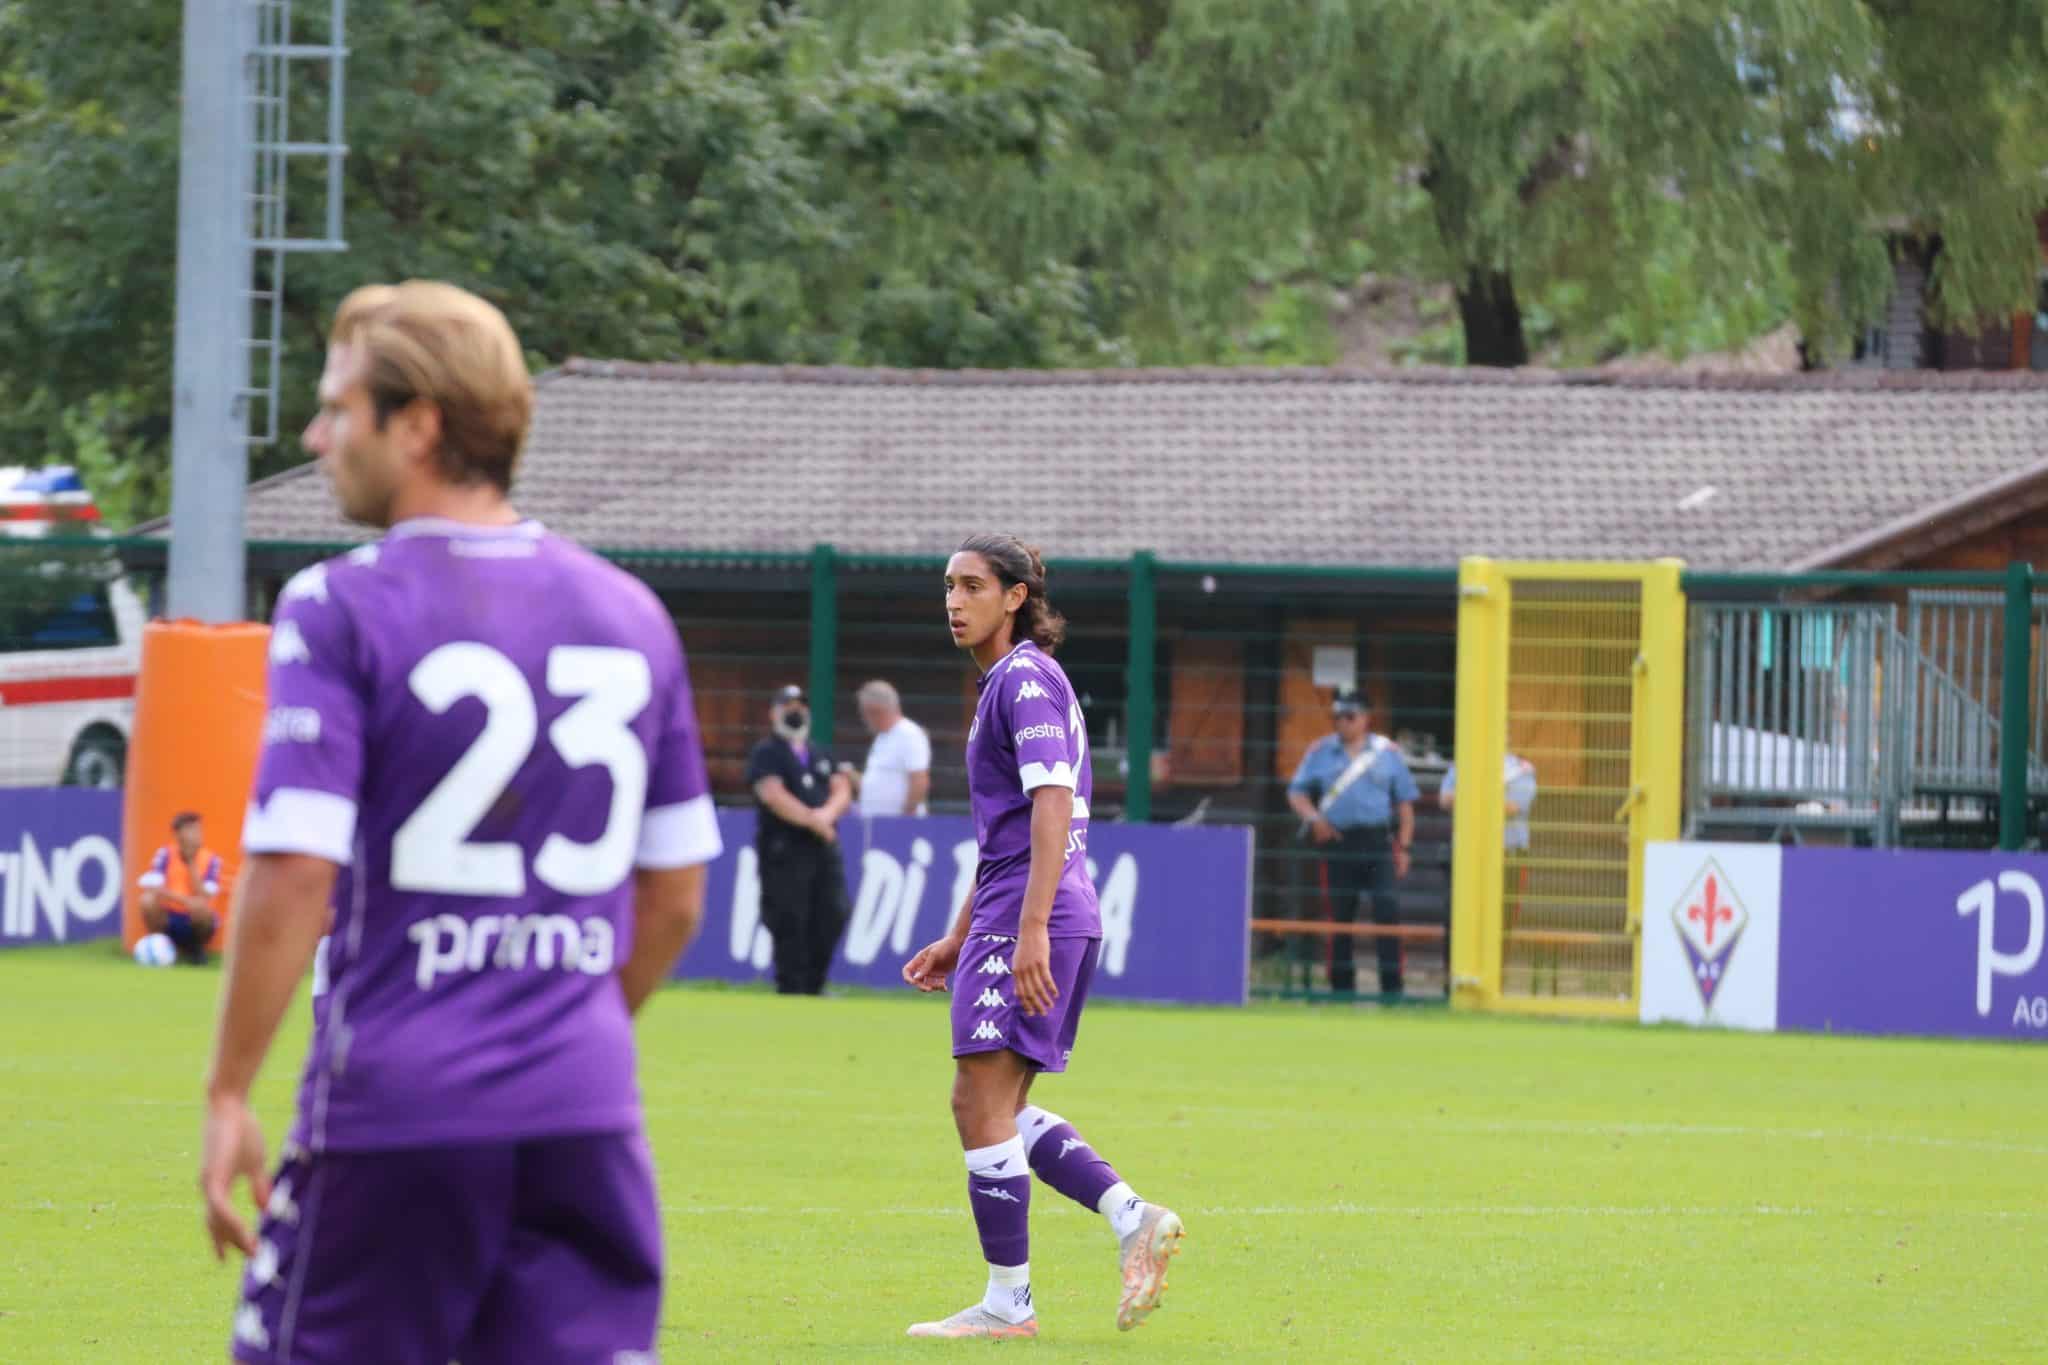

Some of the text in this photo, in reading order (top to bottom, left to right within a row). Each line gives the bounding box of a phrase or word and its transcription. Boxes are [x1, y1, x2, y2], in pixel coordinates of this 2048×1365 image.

[390, 641, 652, 898] 23
[408, 913, 615, 992] prima
[2012, 994, 2048, 1029] AG
